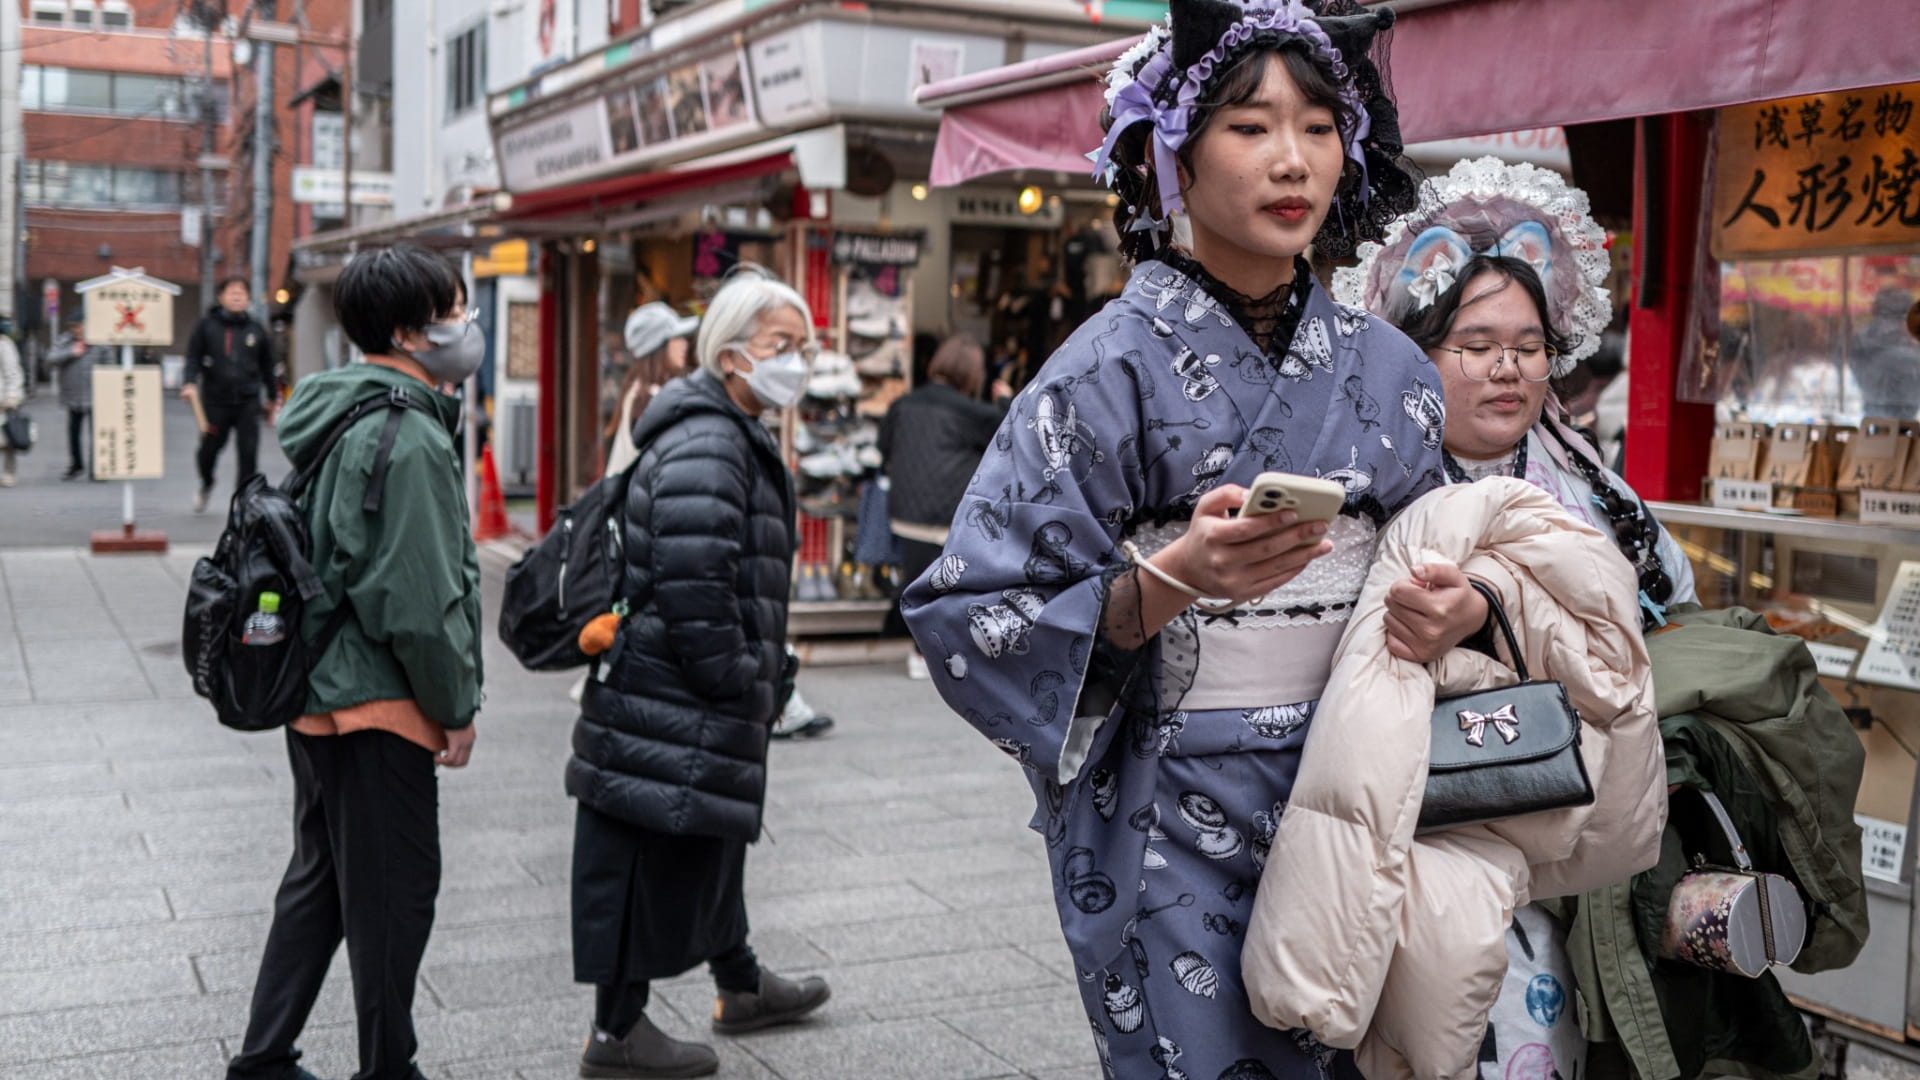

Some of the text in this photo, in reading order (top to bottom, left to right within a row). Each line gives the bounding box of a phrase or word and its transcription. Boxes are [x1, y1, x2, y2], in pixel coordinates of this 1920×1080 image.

[1754, 91, 1913, 150] 浅草名物
[1722, 148, 1920, 232] 人形焼
[853, 236, 918, 261] PALLADIUM
